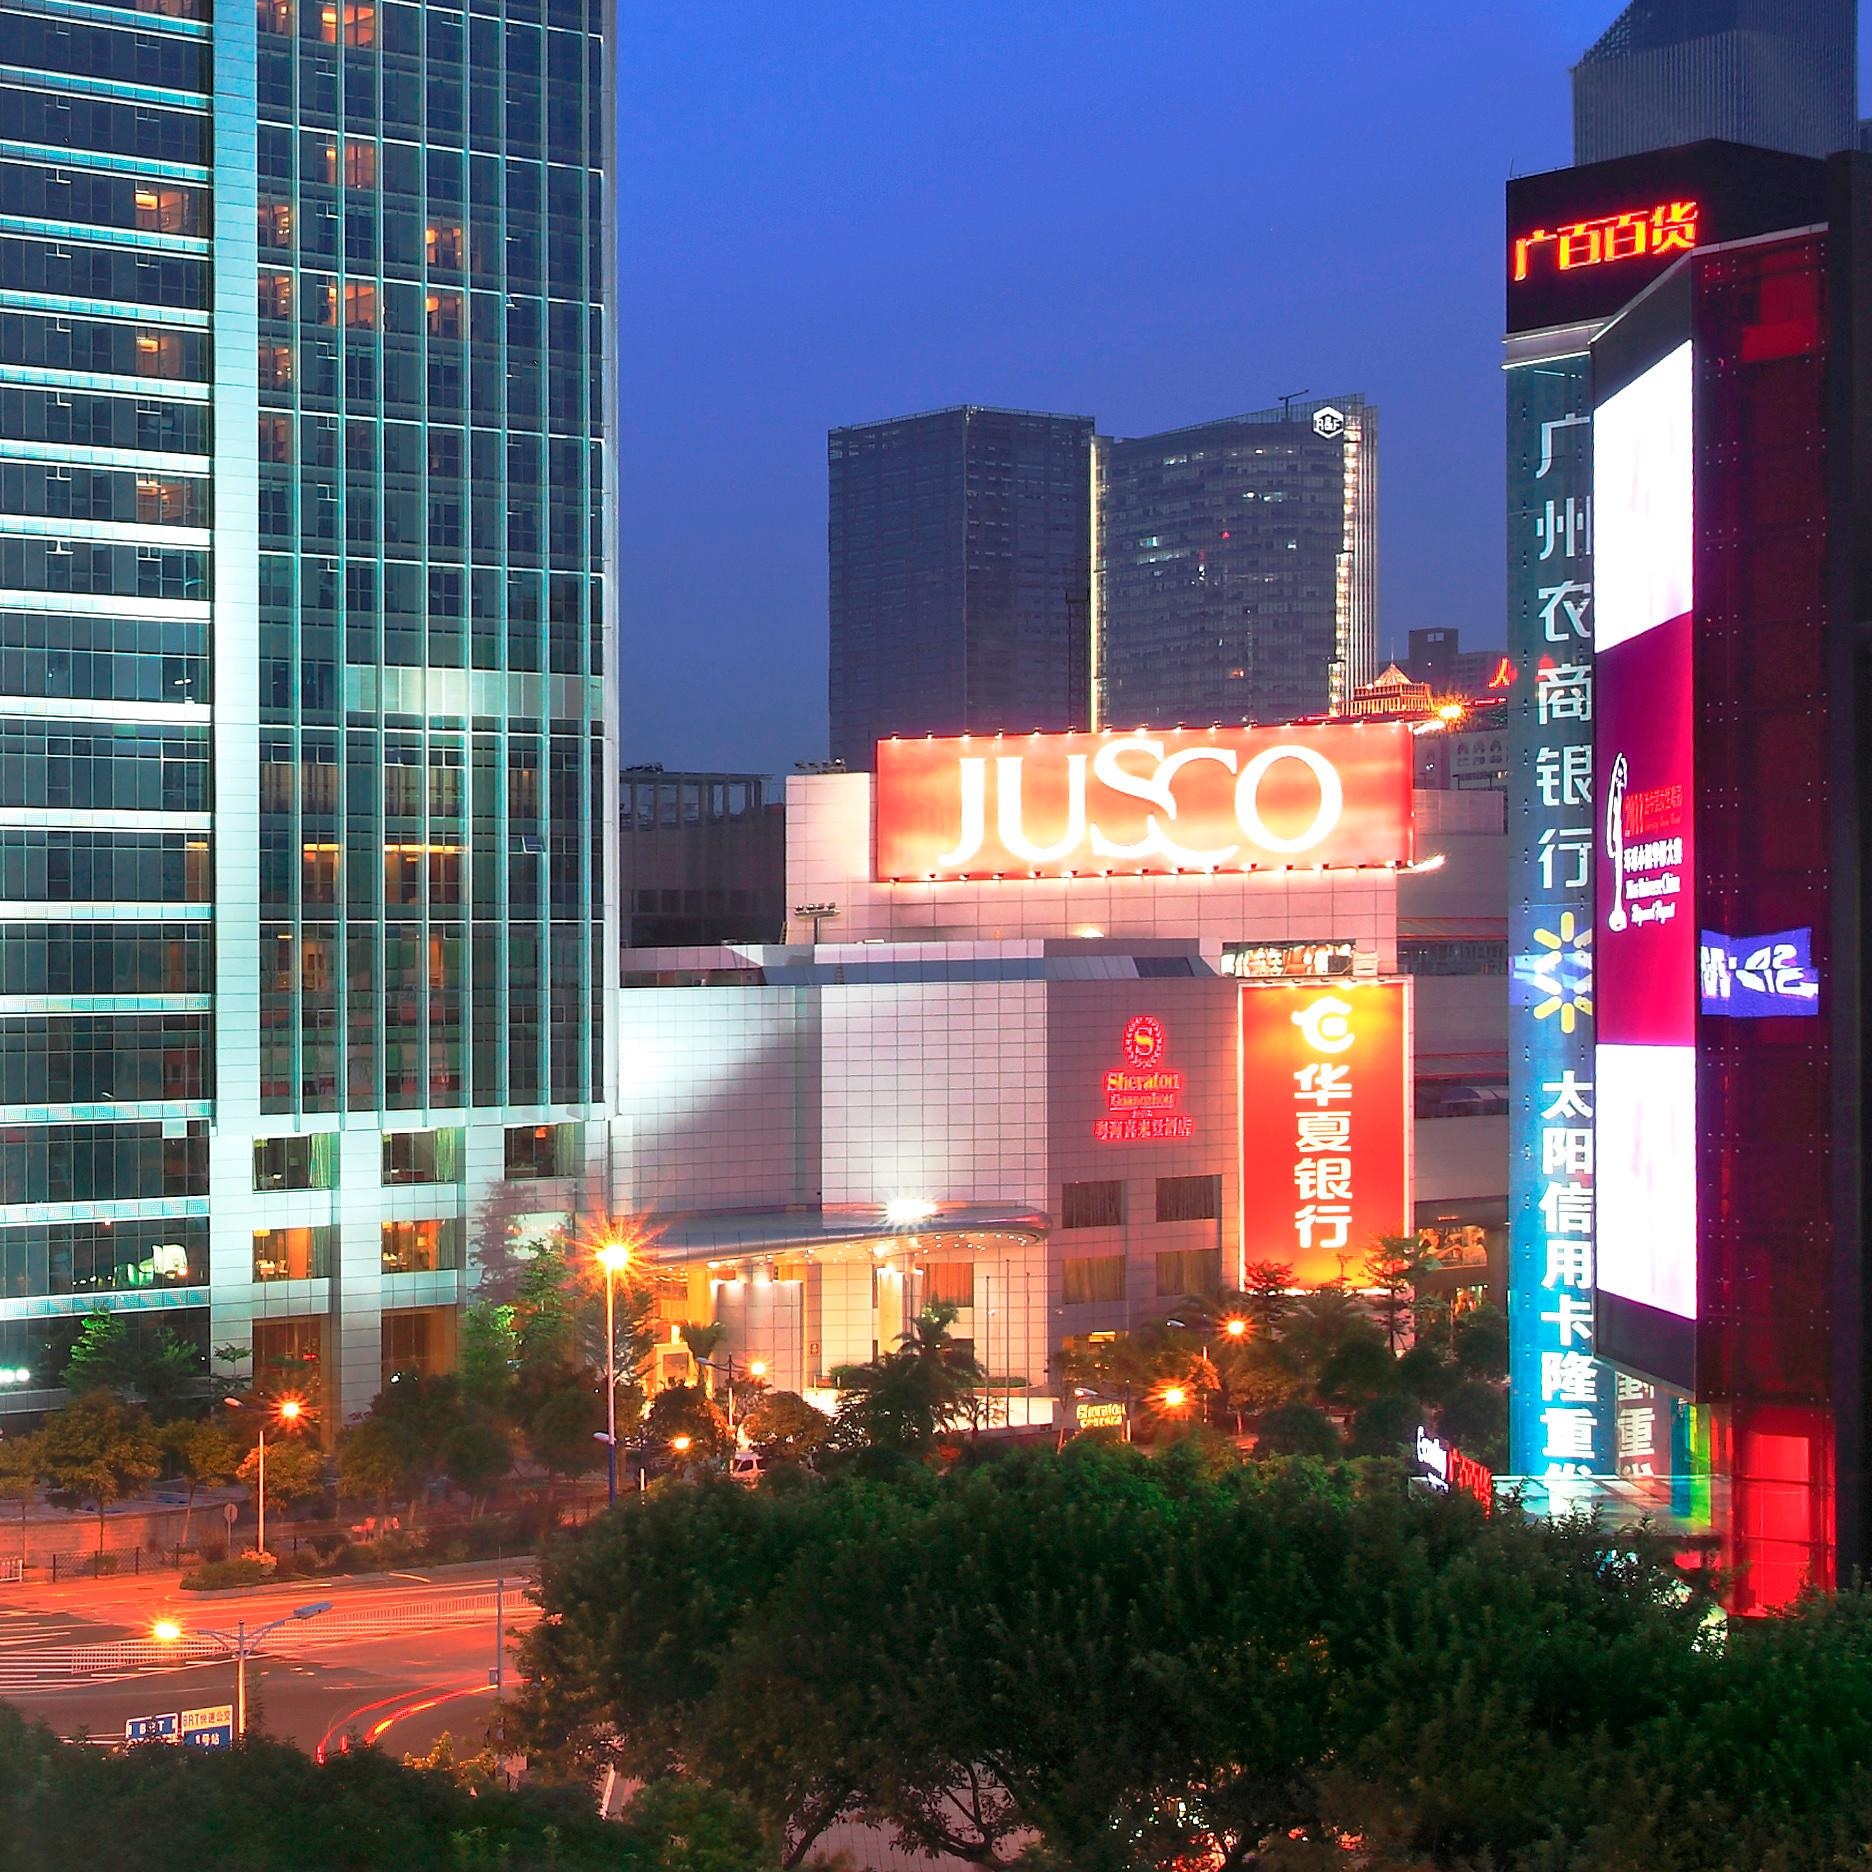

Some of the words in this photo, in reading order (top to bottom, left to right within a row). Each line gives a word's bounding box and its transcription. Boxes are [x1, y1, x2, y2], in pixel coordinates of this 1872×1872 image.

[1514, 201, 1698, 282] 广百百货
[1535, 412, 1592, 890] 广州农商银行
[937, 738, 1343, 868] JUSCO
[1107, 1071, 1181, 1091] Sheraton
[1293, 1062, 1354, 1249] 华夏银行
